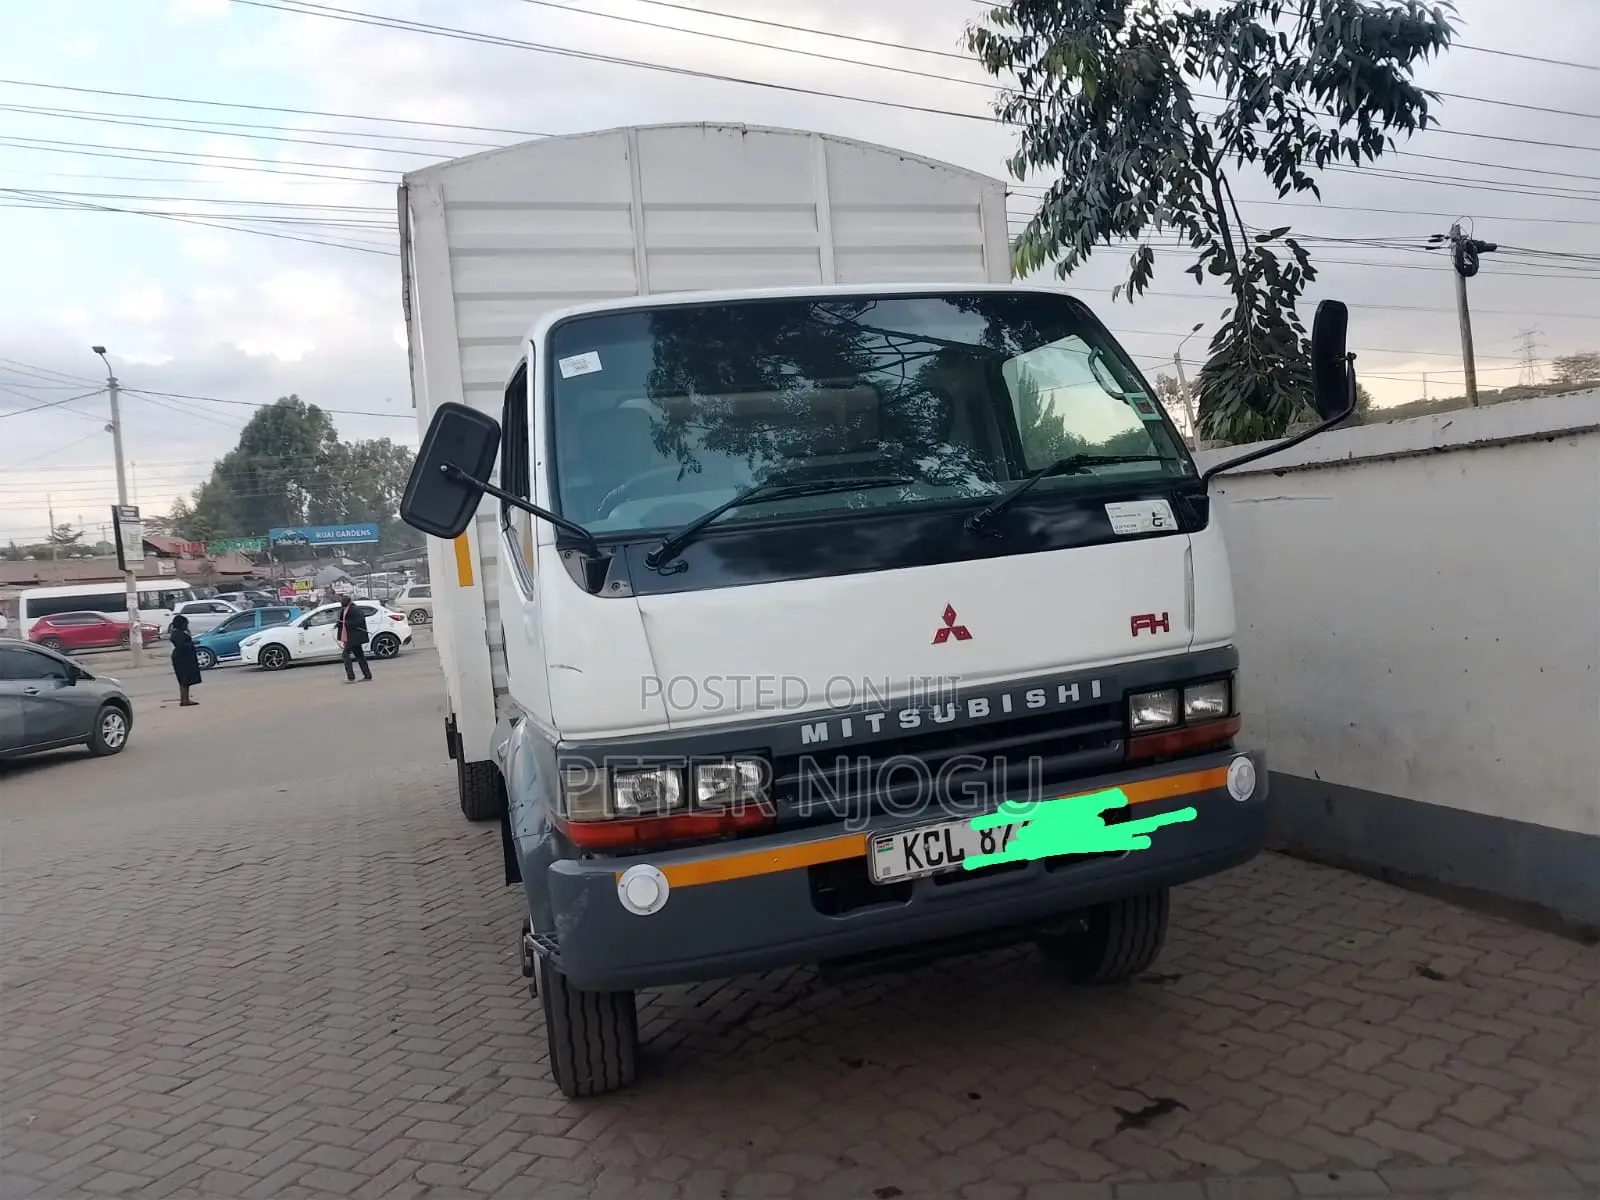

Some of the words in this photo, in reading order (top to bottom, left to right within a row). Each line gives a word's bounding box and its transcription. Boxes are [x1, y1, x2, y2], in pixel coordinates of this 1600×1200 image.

[335, 529, 371, 538] GARDENS
[1131, 612, 1169, 637] FH
[801, 679, 1101, 744] MITSUBISHI
[903, 829, 965, 870] KCL
[979, 820, 1032, 855] 87
